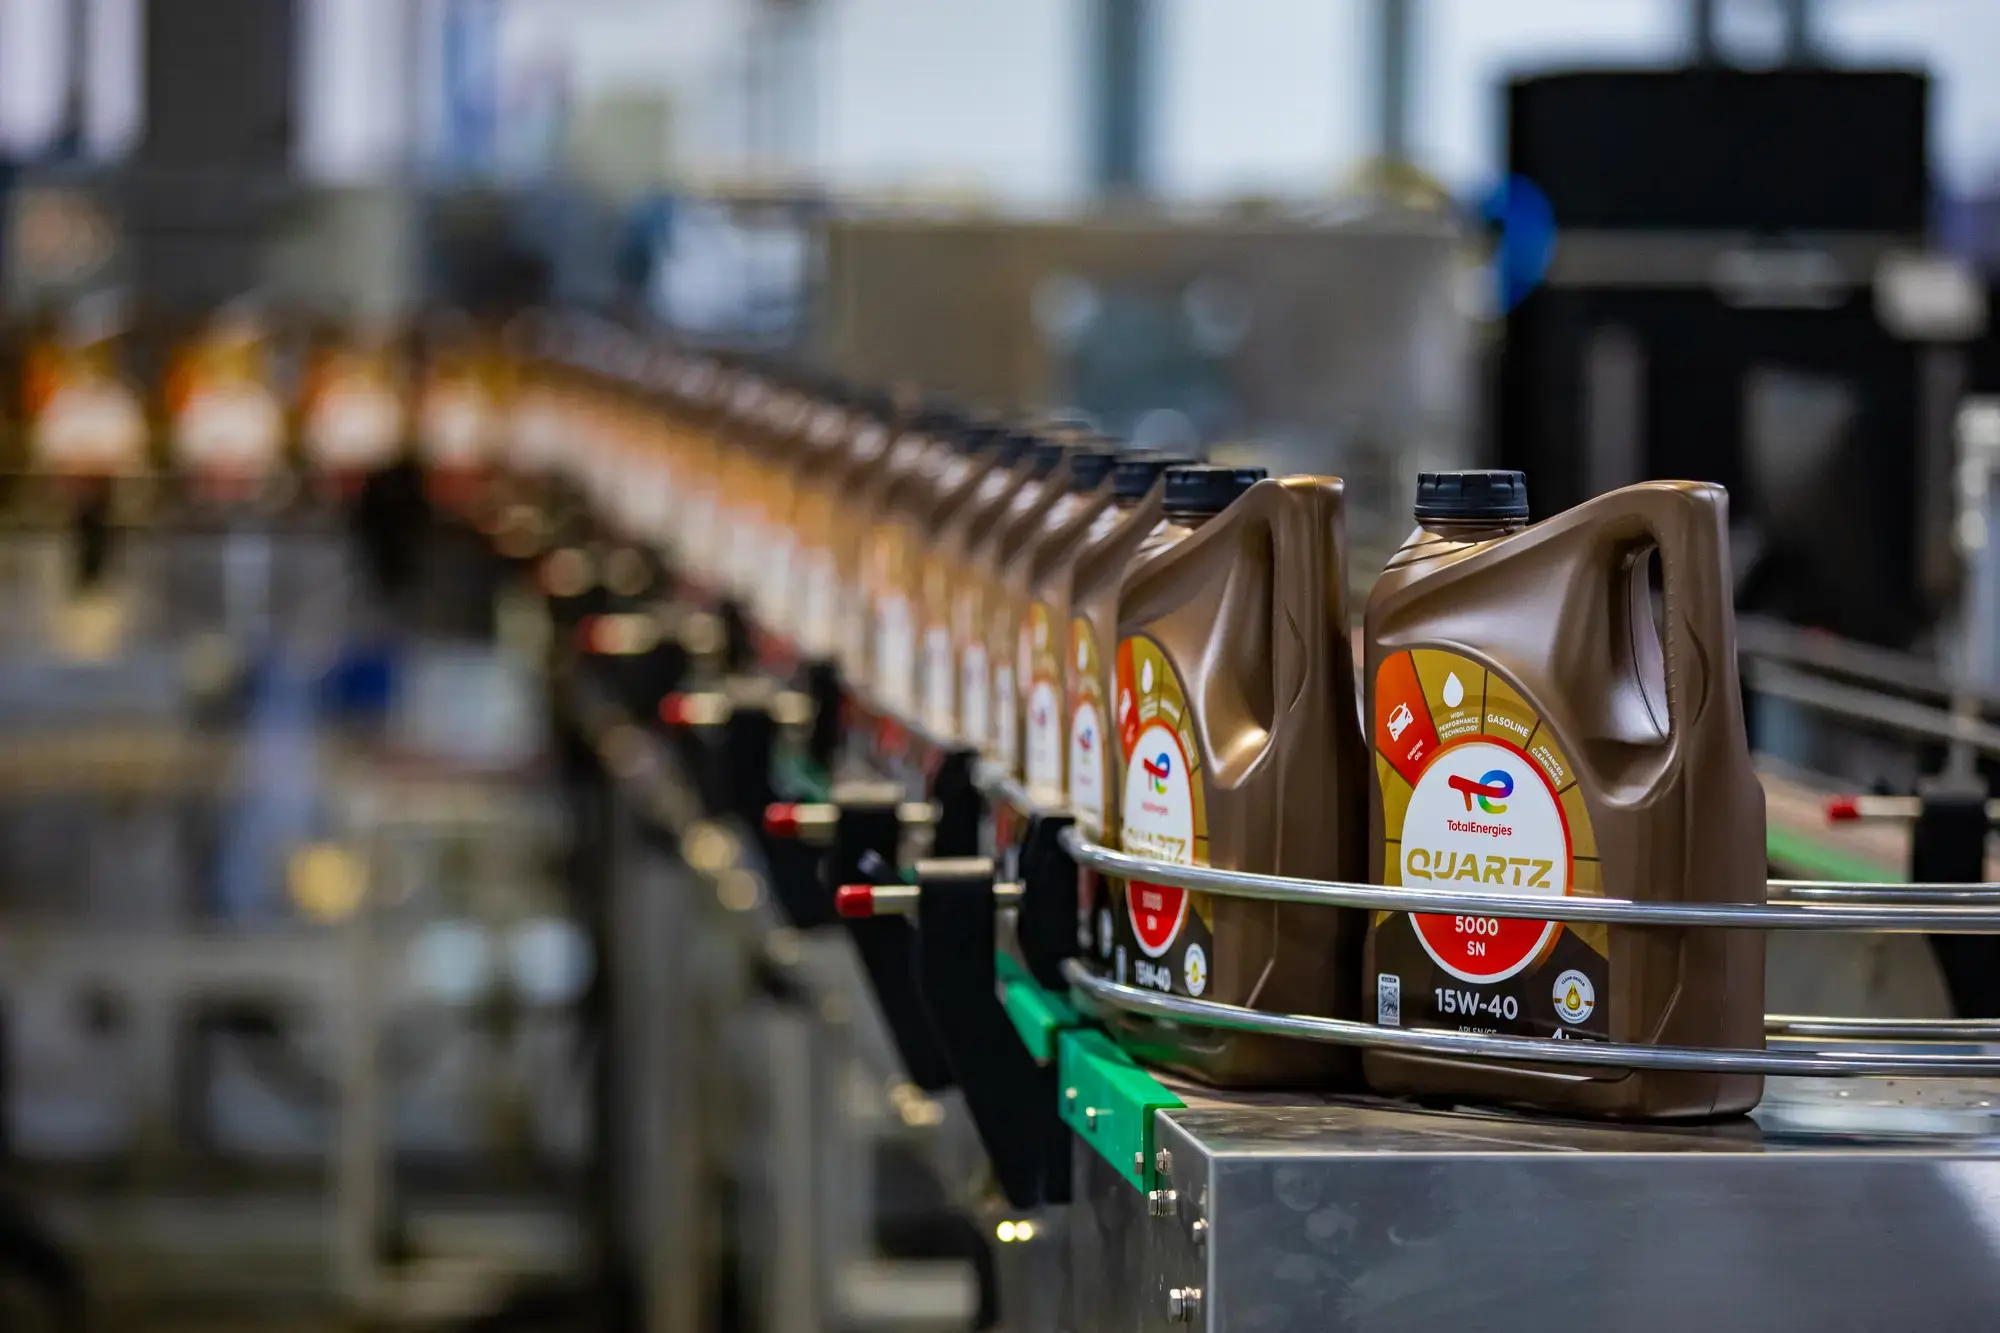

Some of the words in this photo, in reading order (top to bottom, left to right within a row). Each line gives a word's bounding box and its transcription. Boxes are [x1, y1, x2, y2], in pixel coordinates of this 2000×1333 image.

[1438, 716, 1479, 733] PERFORMANCE
[1450, 710, 1464, 719] HIGH
[1487, 713, 1530, 738] GASOLINE
[1441, 725, 1478, 740] TECHNOLOGY
[1407, 739, 1424, 761] ENGINE
[1414, 751, 1423, 761] OIL
[1539, 745, 1564, 777] ADVANCED
[1531, 747, 1562, 786] CLEANLINESS
[1446, 819, 1513, 838] TotalEnergies
[1406, 847, 1554, 889] QUARTZ
[1454, 915, 1499, 937] 5000
[1466, 940, 1486, 957] SN
[1434, 987, 1519, 1021] 15W-40
